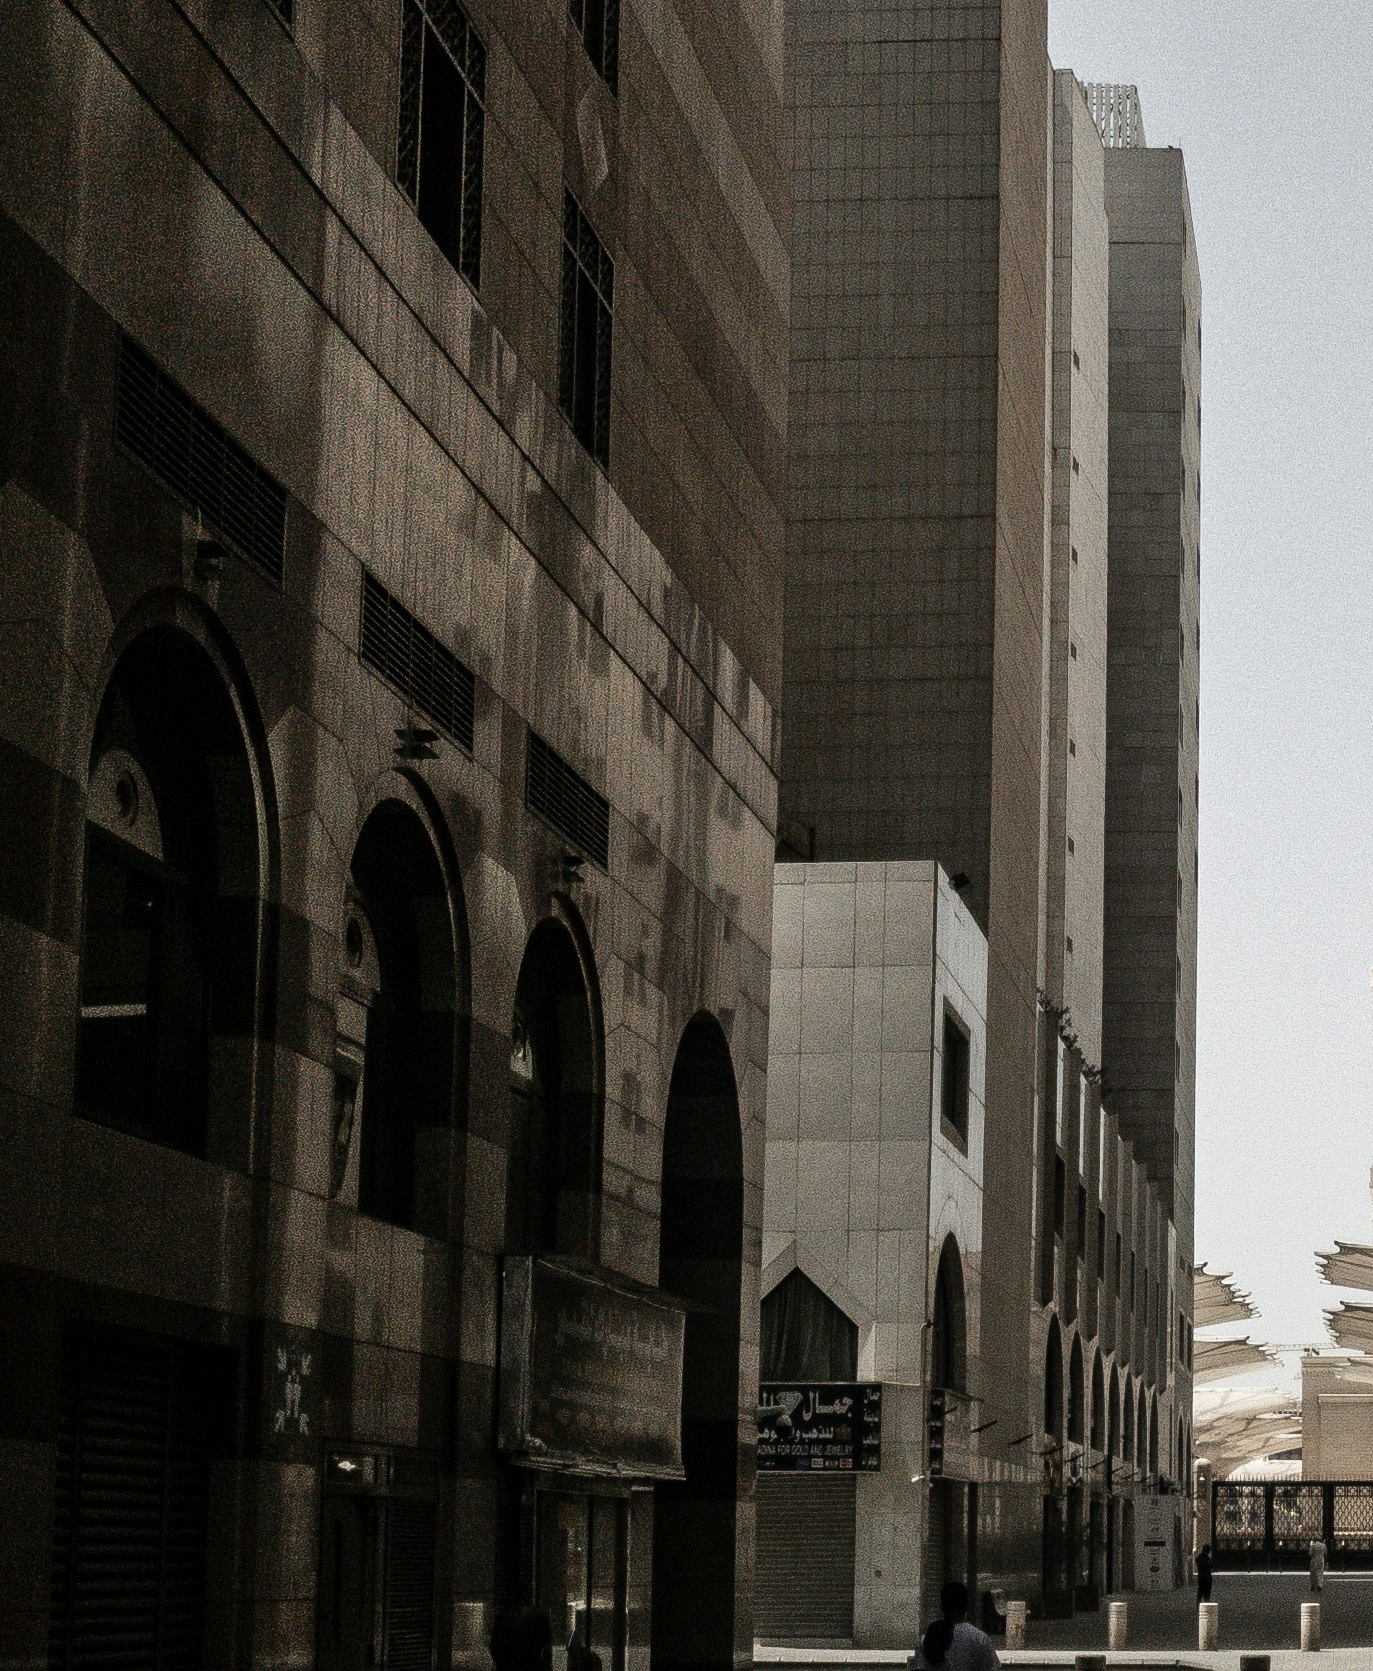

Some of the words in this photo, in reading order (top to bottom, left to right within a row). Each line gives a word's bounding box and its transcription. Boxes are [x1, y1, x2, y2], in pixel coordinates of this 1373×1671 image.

[802, 1390, 854, 1422] جمال
[802, 1426, 835, 1443] للذهب
[757, 1444, 776, 1456] ADINA
[777, 1444, 791, 1456] FOR
[791, 1444, 809, 1456] GOLD
[810, 1444, 823, 1456] AND
[824, 1444, 853, 1456] JEWELRY
